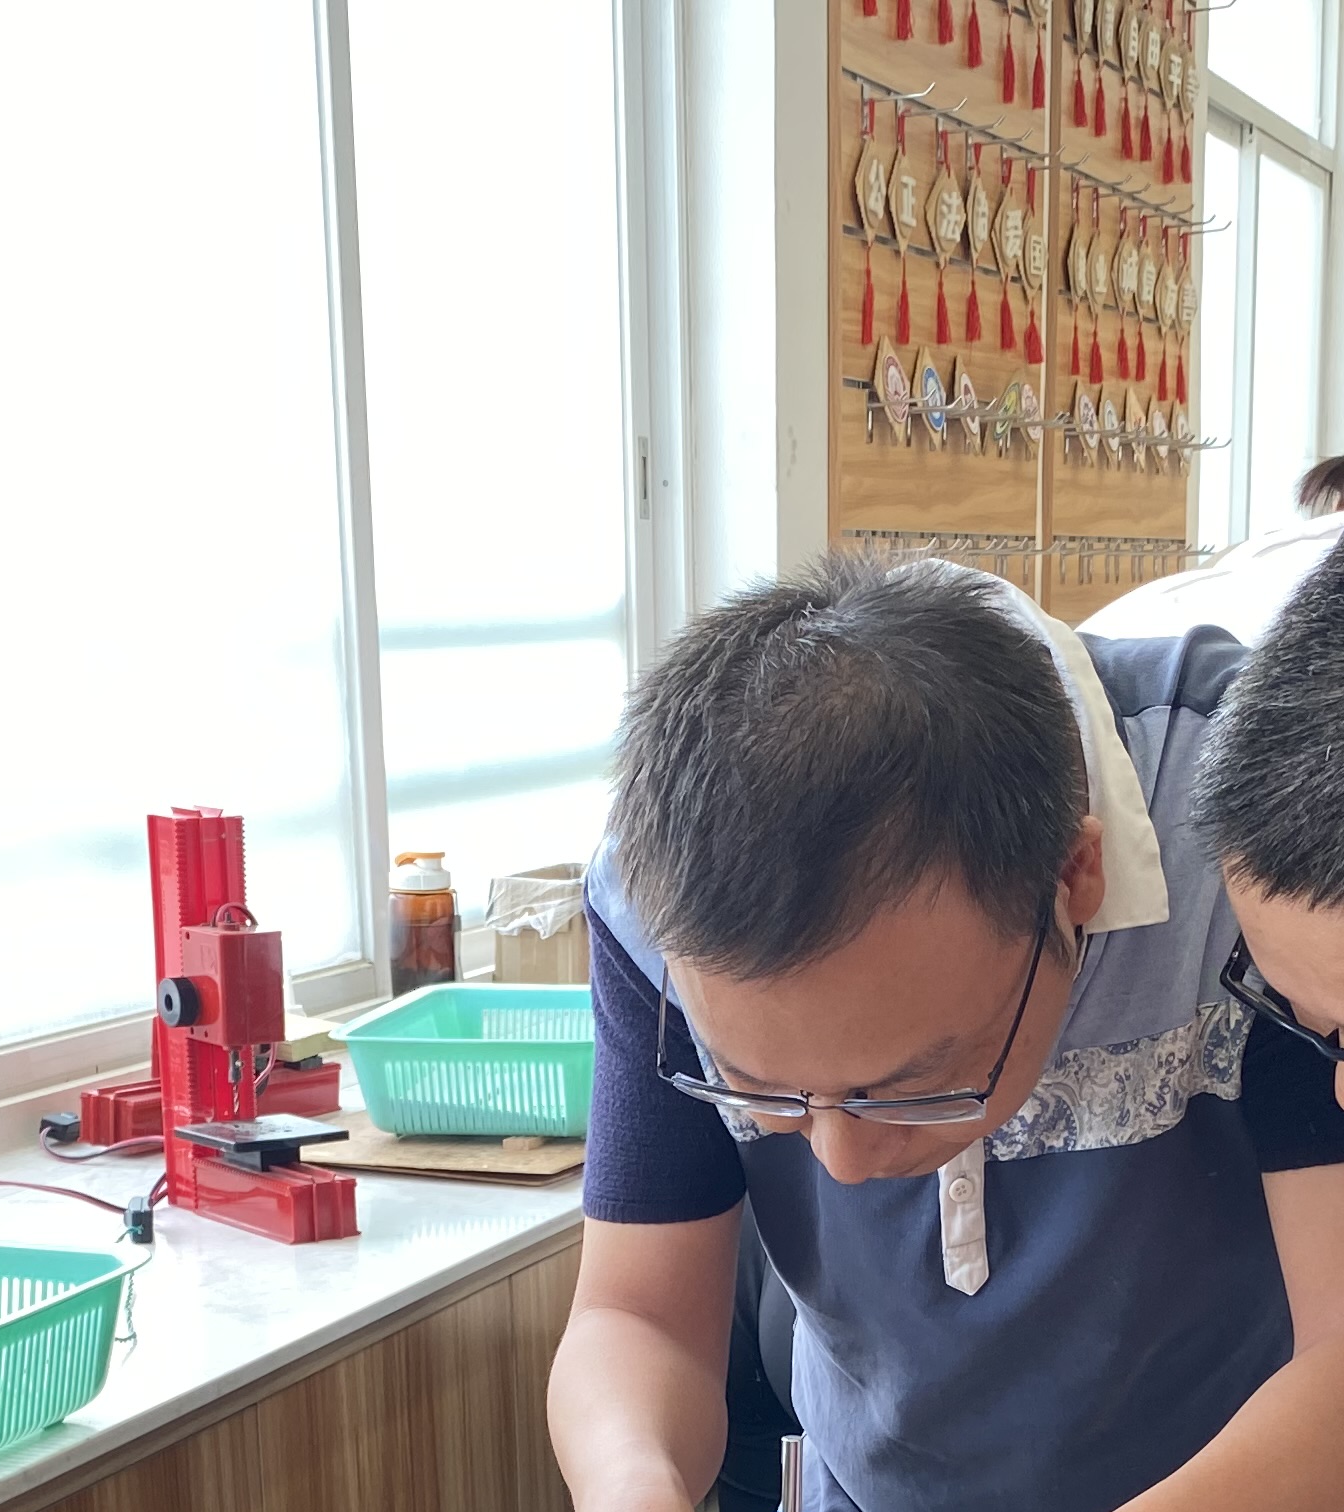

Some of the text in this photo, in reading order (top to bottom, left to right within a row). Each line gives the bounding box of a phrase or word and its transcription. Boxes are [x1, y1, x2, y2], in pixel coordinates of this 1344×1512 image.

[868, 159, 887, 221] 公
[899, 175, 917, 228] 正
[940, 191, 961, 243] 法
[1006, 209, 1022, 259] 爱
[1030, 235, 1046, 276] 国
